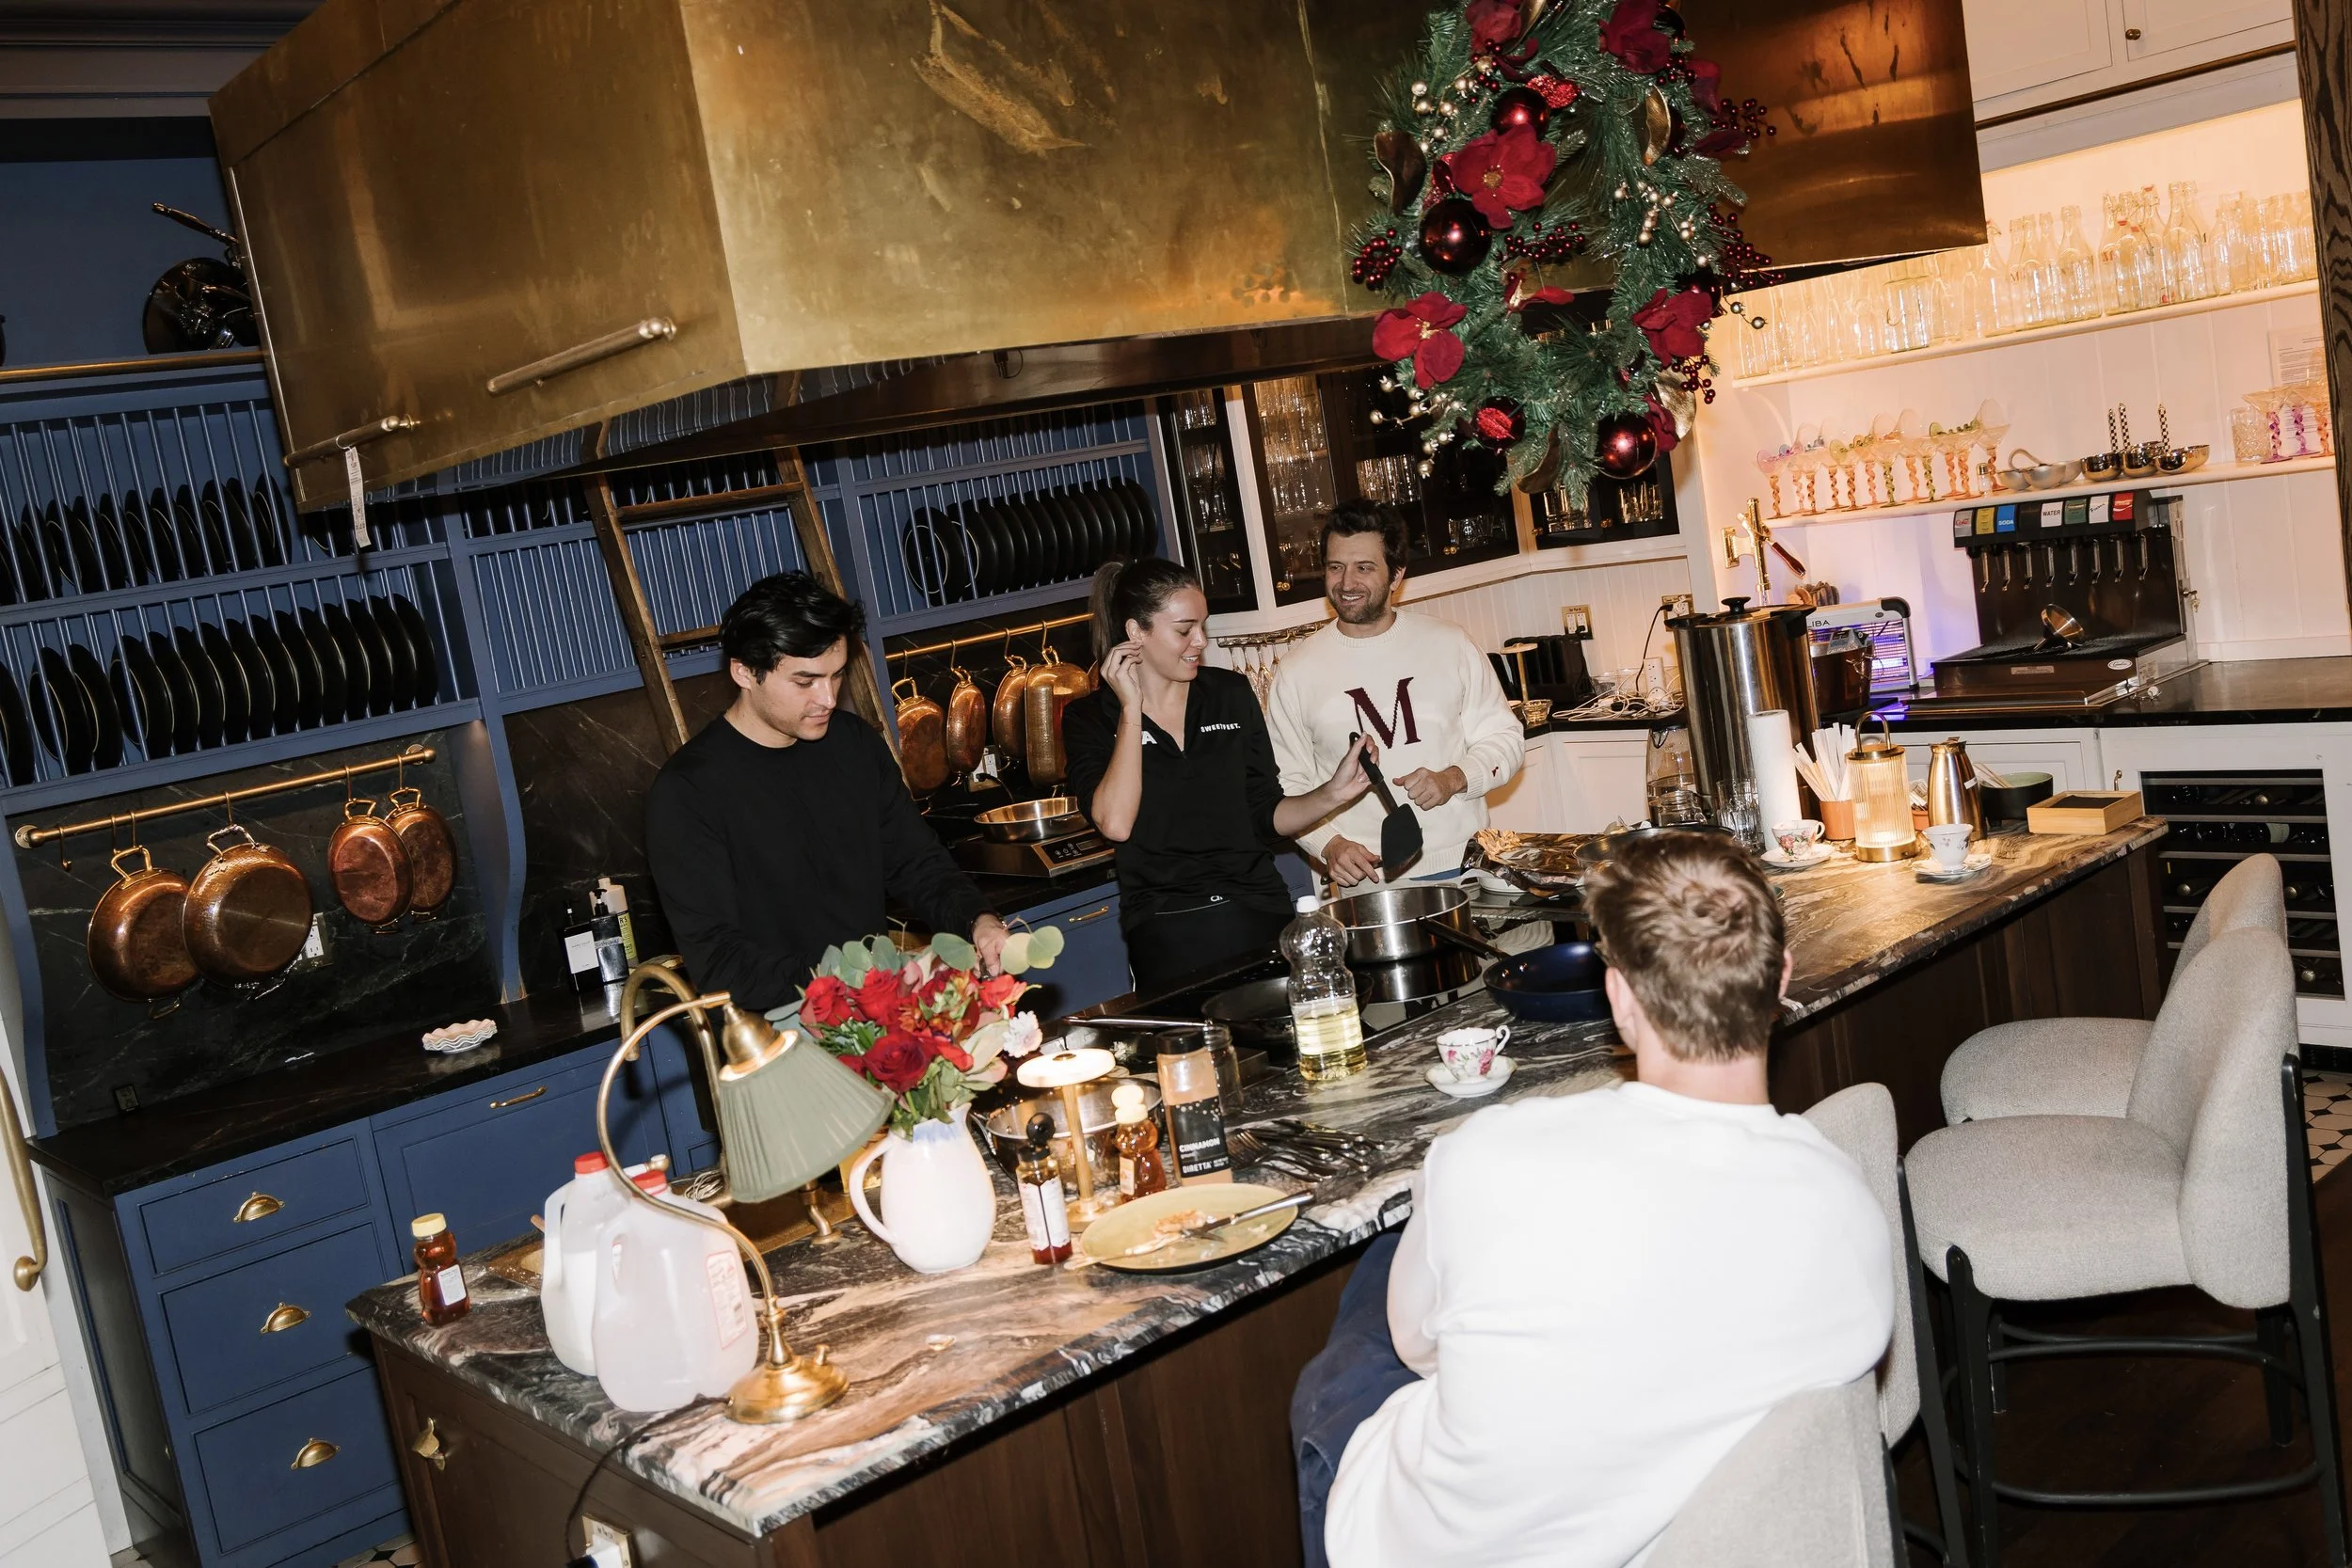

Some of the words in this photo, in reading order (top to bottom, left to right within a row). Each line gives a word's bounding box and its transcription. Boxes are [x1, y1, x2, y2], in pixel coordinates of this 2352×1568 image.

[2042, 509, 2061, 517] WATER
[1807, 620, 1830, 628] IBA
[1343, 676, 1422, 750] M
[1179, 1137, 1221, 1153] CINNAMON
